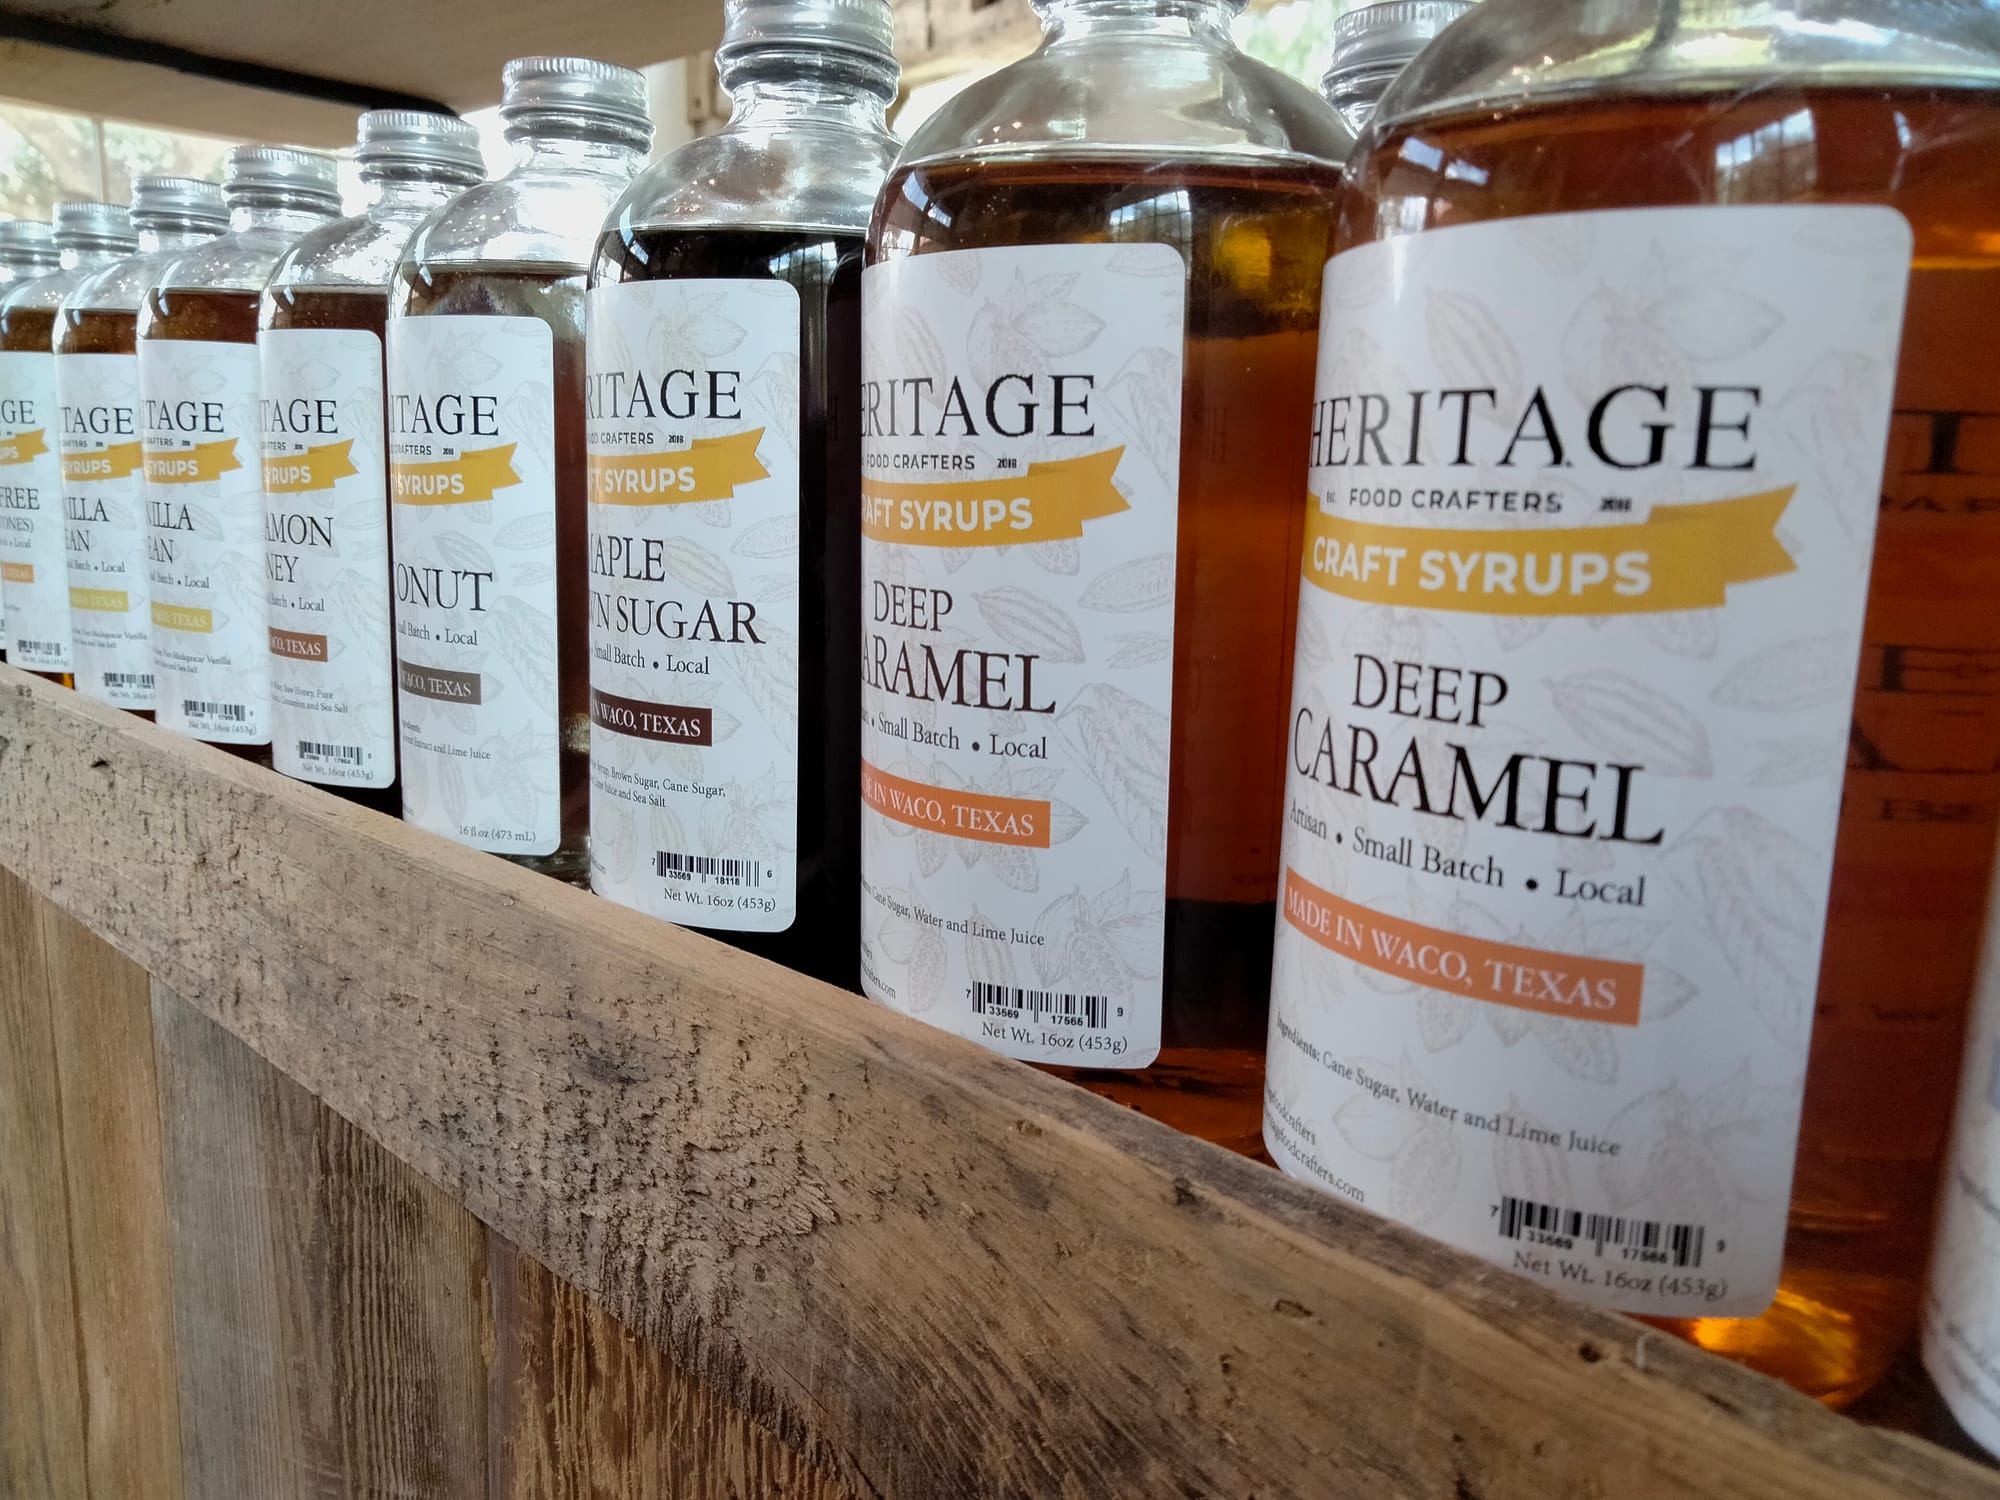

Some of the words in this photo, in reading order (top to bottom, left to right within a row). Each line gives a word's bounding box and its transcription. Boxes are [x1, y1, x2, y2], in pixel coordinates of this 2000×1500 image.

[61, 406, 134, 435] TAGE
[144, 400, 224, 433] TAGE
[260, 398, 338, 434] TAGE
[1309, 384, 1761, 471] HERITAGE
[600, 432, 654, 445] CRAFTERS
[893, 454, 975, 471] CRAFTERS
[997, 458, 1017, 469] 2018
[604, 466, 696, 493] SYRUPS
[900, 497, 1033, 531] SYRUPS
[1349, 488, 1402, 508] FOOD
[1411, 489, 1563, 514] CRAFTERS
[101, 561, 126, 573] Local
[1313, 535, 1406, 586] CRAFT
[1418, 550, 1652, 596] SYRUPS
[185, 575, 210, 589] Local
[299, 597, 325, 612] Local
[616, 595, 766, 645] SUGAR
[873, 579, 953, 632] DEEP
[285, 639, 322, 656] TEXAS
[445, 628, 478, 646] Local
[614, 646, 645, 669] Batch
[666, 654, 710, 676] Local
[428, 677, 472, 697] TEXAS
[1351, 653, 1509, 728] DEEP
[600, 702, 637, 730] WACO,
[640, 712, 701, 737] TEXAS
[878, 711, 908, 740] Small
[912, 721, 960, 750] Batch
[989, 733, 1048, 760] Local
[447, 745, 467, 757] Lime
[470, 747, 491, 760] Juice
[611, 767, 633, 784] Brown
[634, 773, 660, 790] Sugar,
[662, 779, 689, 793] Cane
[691, 782, 726, 799] Sugar,
[1294, 707, 1665, 847] CARAMEL
[618, 789, 632, 801] and
[633, 790, 647, 804] Sea
[649, 793, 666, 808] Salt
[873, 780, 887, 804] IN
[889, 788, 946, 828] WACO,
[951, 804, 1034, 836] TEXAS
[459, 825, 469, 835] 16
[491, 829, 512, 841] (473
[514, 831, 537, 844] mL)
[1290, 800, 1328, 840] Artisan
[1352, 826, 1413, 868] Small
[1421, 846, 1505, 889] Batch
[1554, 868, 1646, 907] Local
[651, 858, 656, 866] 7
[668, 870, 692, 881] 33569
[715, 876, 740, 886] 18118
[767, 870, 773, 878] 6
[664, 888, 682, 901] Net
[685, 891, 704, 905] Wt.
[708, 894, 734, 908] 16oz
[737, 897, 776, 913] (453g)
[886, 895, 911, 919] Sugar,
[913, 906, 943, 928] Water
[946, 920, 968, 934] and
[972, 921, 1006, 941] Lime
[1010, 928, 1046, 946] Juice
[1288, 885, 1332, 937] MADE
[1336, 918, 1364, 952] IN
[1371, 927, 1473, 988] WACO,
[1483, 959, 1618, 1011] TEXAS
[966, 989, 971, 999] 7
[1117, 1007, 1124, 1017] 9
[982, 1021, 1006, 1040] Net
[1010, 1026, 1035, 1045] Wt.
[1040, 1031, 1074, 1049] 16oz
[1078, 1034, 1128, 1055] (453g)
[1276, 1010, 1320, 1062] Ingredients:
[1322, 1051, 1353, 1081] Cane
[1355, 1067, 1402, 1104] Sugar,
[1406, 1087, 1459, 1123] Water
[1463, 1111, 1500, 1134] and
[1507, 1118, 1561, 1148] Lime
[1567, 1129, 1621, 1157] Juice
[1490, 1204, 1499, 1218] 7
[1716, 1238, 1726, 1254] 9
[1512, 1251, 1551, 1275] Net
[1558, 1260, 1595, 1285] Wt.
[1603, 1270, 1652, 1293] 16oz
[1658, 1276, 1729, 1302] (453g)
